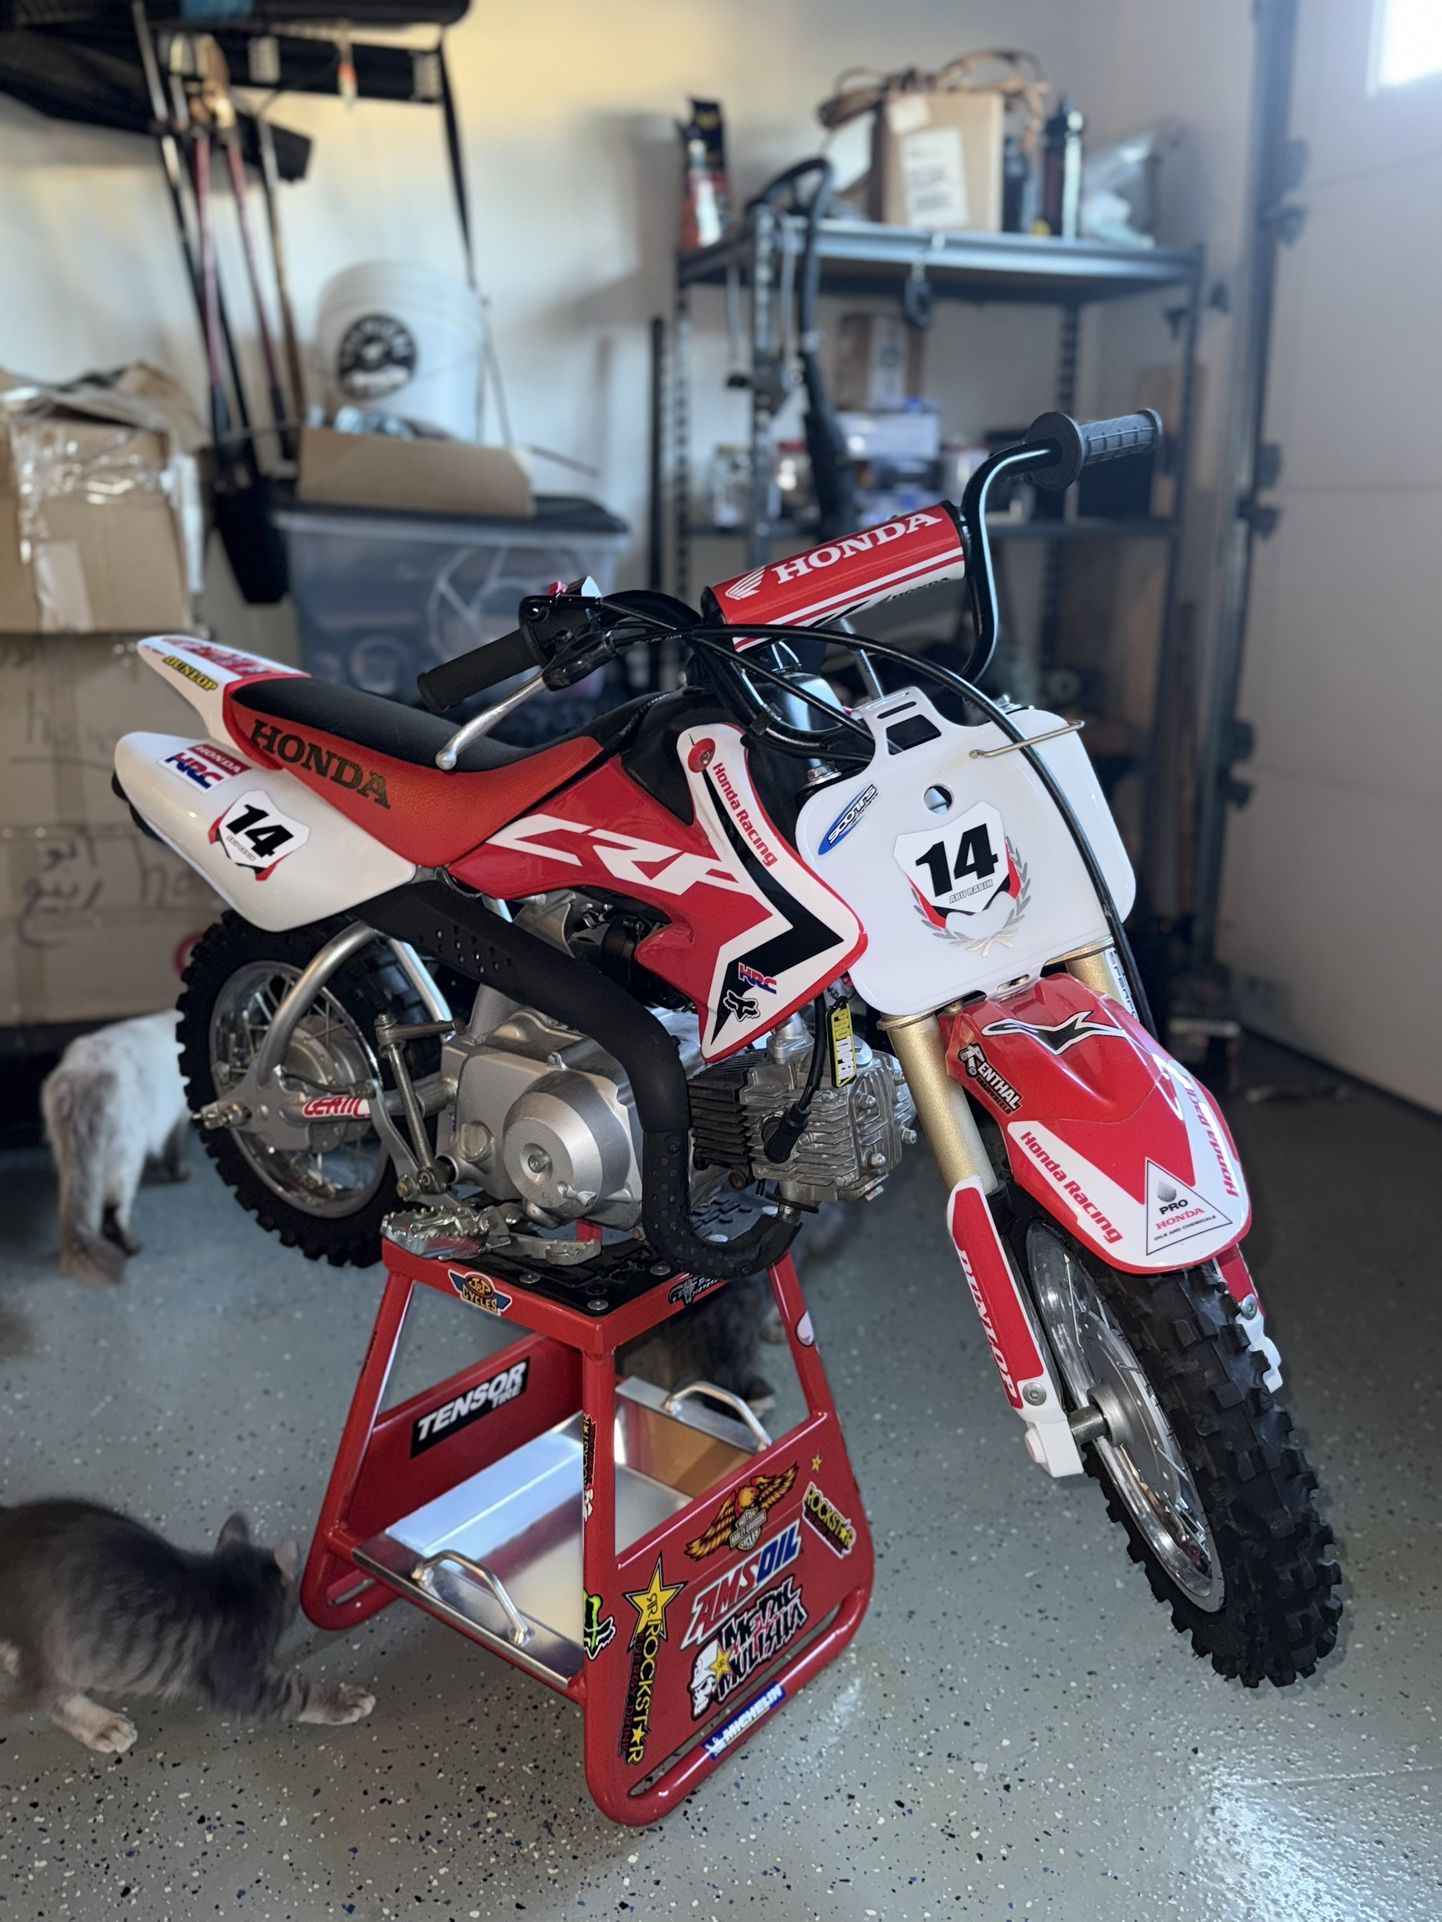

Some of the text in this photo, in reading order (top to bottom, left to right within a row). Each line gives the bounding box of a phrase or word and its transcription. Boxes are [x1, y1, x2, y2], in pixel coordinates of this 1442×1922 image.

[771, 513, 943, 584] HONDA
[164, 656, 217, 690] DUNLOP
[165, 752, 224, 789] HRC
[195, 746, 242, 774] HONDA
[250, 719, 392, 809] HONDA
[225, 803, 294, 858] 14
[713, 762, 778, 867] Honda Racing
[915, 823, 998, 898] 14
[738, 961, 777, 996] HRC
[1021, 1131, 1123, 1244] Honda Racing
[1155, 1208, 1205, 1229] HONDA
[1159, 1199, 1188, 1215] PRO
[462, 1286, 497, 1313] CYCLES
[958, 1249, 1018, 1399] DUNLOP
[418, 1361, 526, 1441] TENSOR
[682, 1523, 801, 1648] AMSOIL
